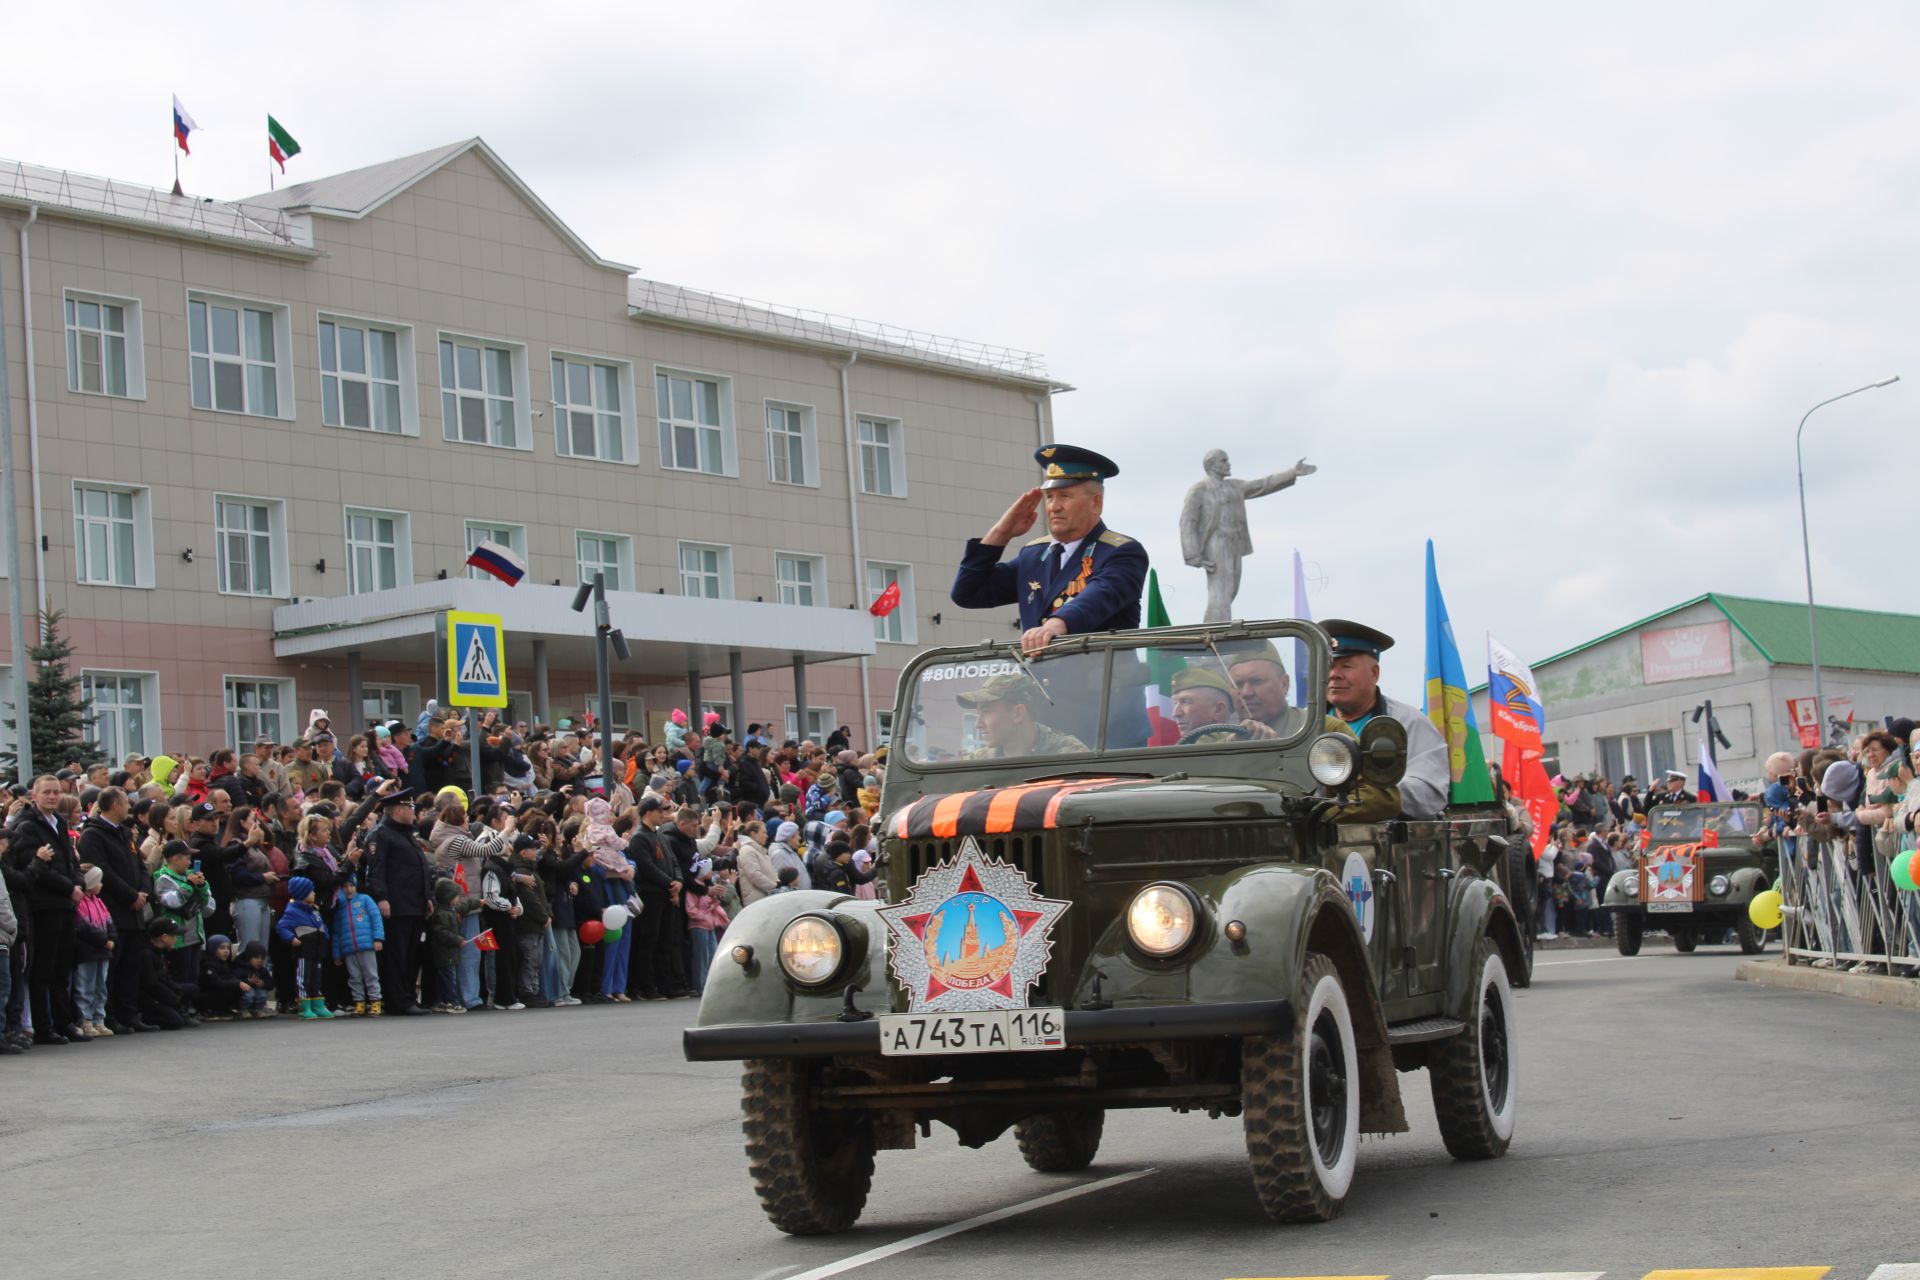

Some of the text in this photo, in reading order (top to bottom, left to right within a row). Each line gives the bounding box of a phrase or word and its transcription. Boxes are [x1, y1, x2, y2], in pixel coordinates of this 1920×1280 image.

[922, 663, 1022, 682] #80ПОБЕДА
[951, 894, 990, 907] СССР
[948, 975, 991, 988] ПОБЕДА
[894, 1013, 1055, 1050] А743ТА 116
[1021, 1036, 1043, 1046] RUS
